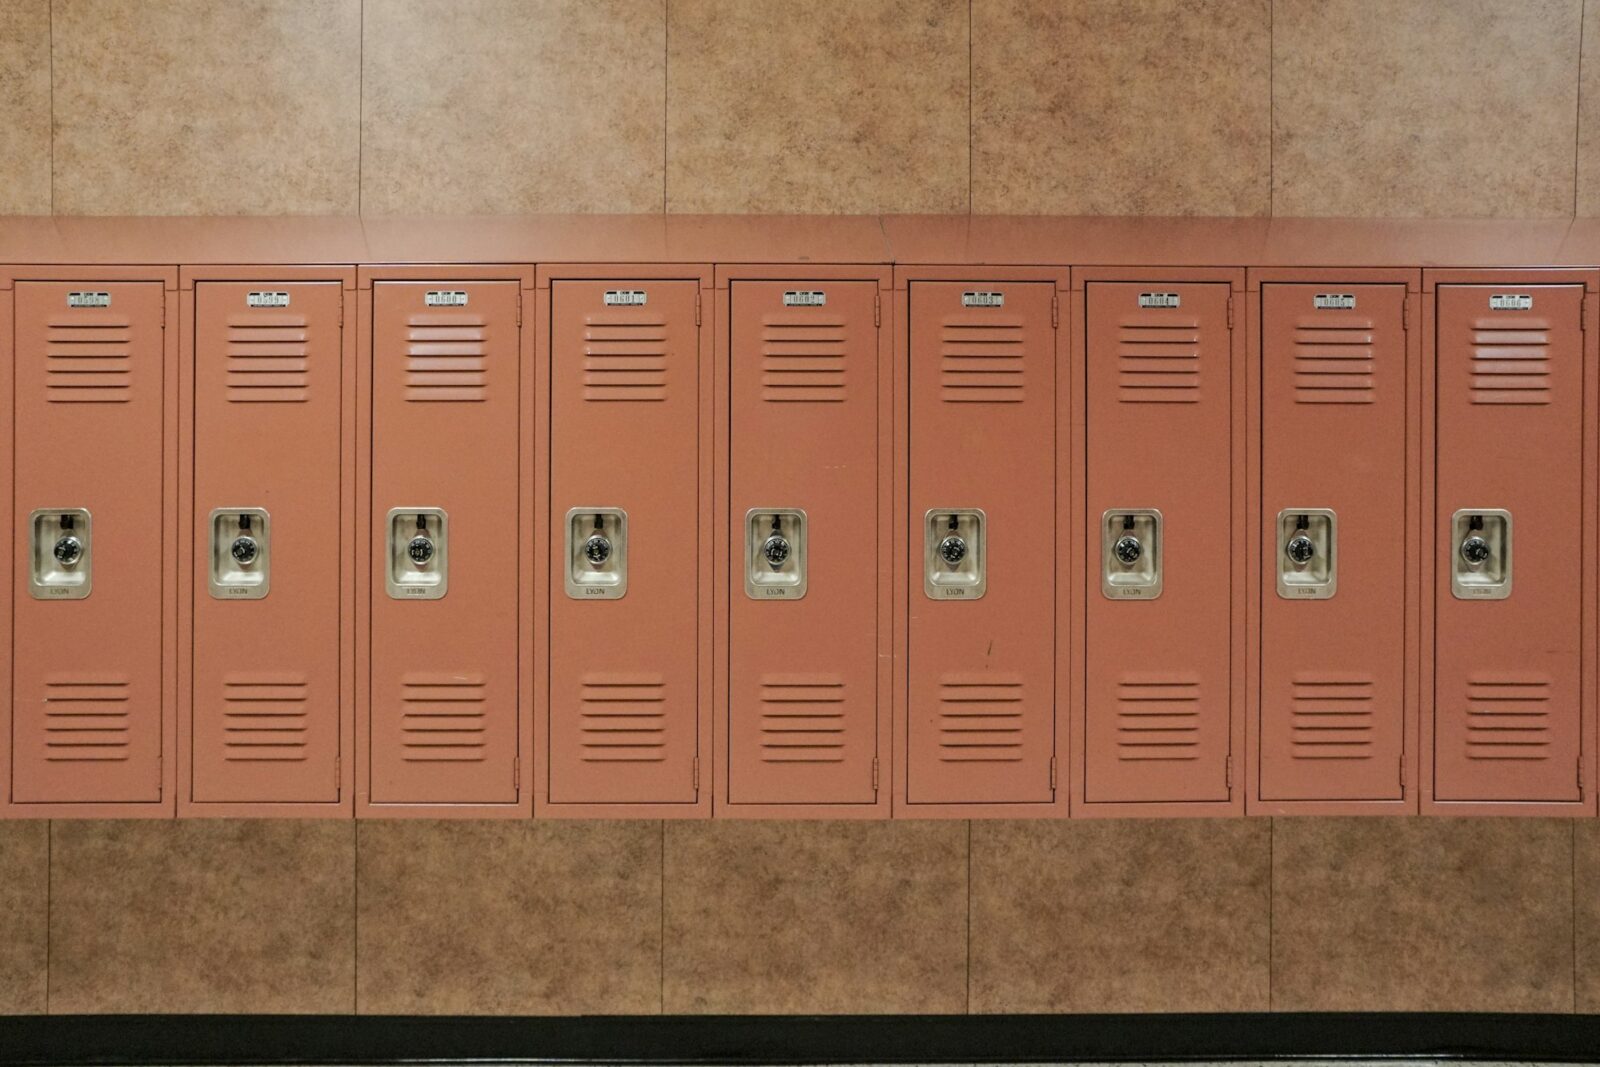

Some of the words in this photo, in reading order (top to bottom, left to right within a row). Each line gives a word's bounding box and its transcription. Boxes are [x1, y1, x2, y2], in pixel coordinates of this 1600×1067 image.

[972, 296, 994, 304] 0603
[1148, 297, 1169, 305] 0604
[1324, 298, 1345, 306] 0605
